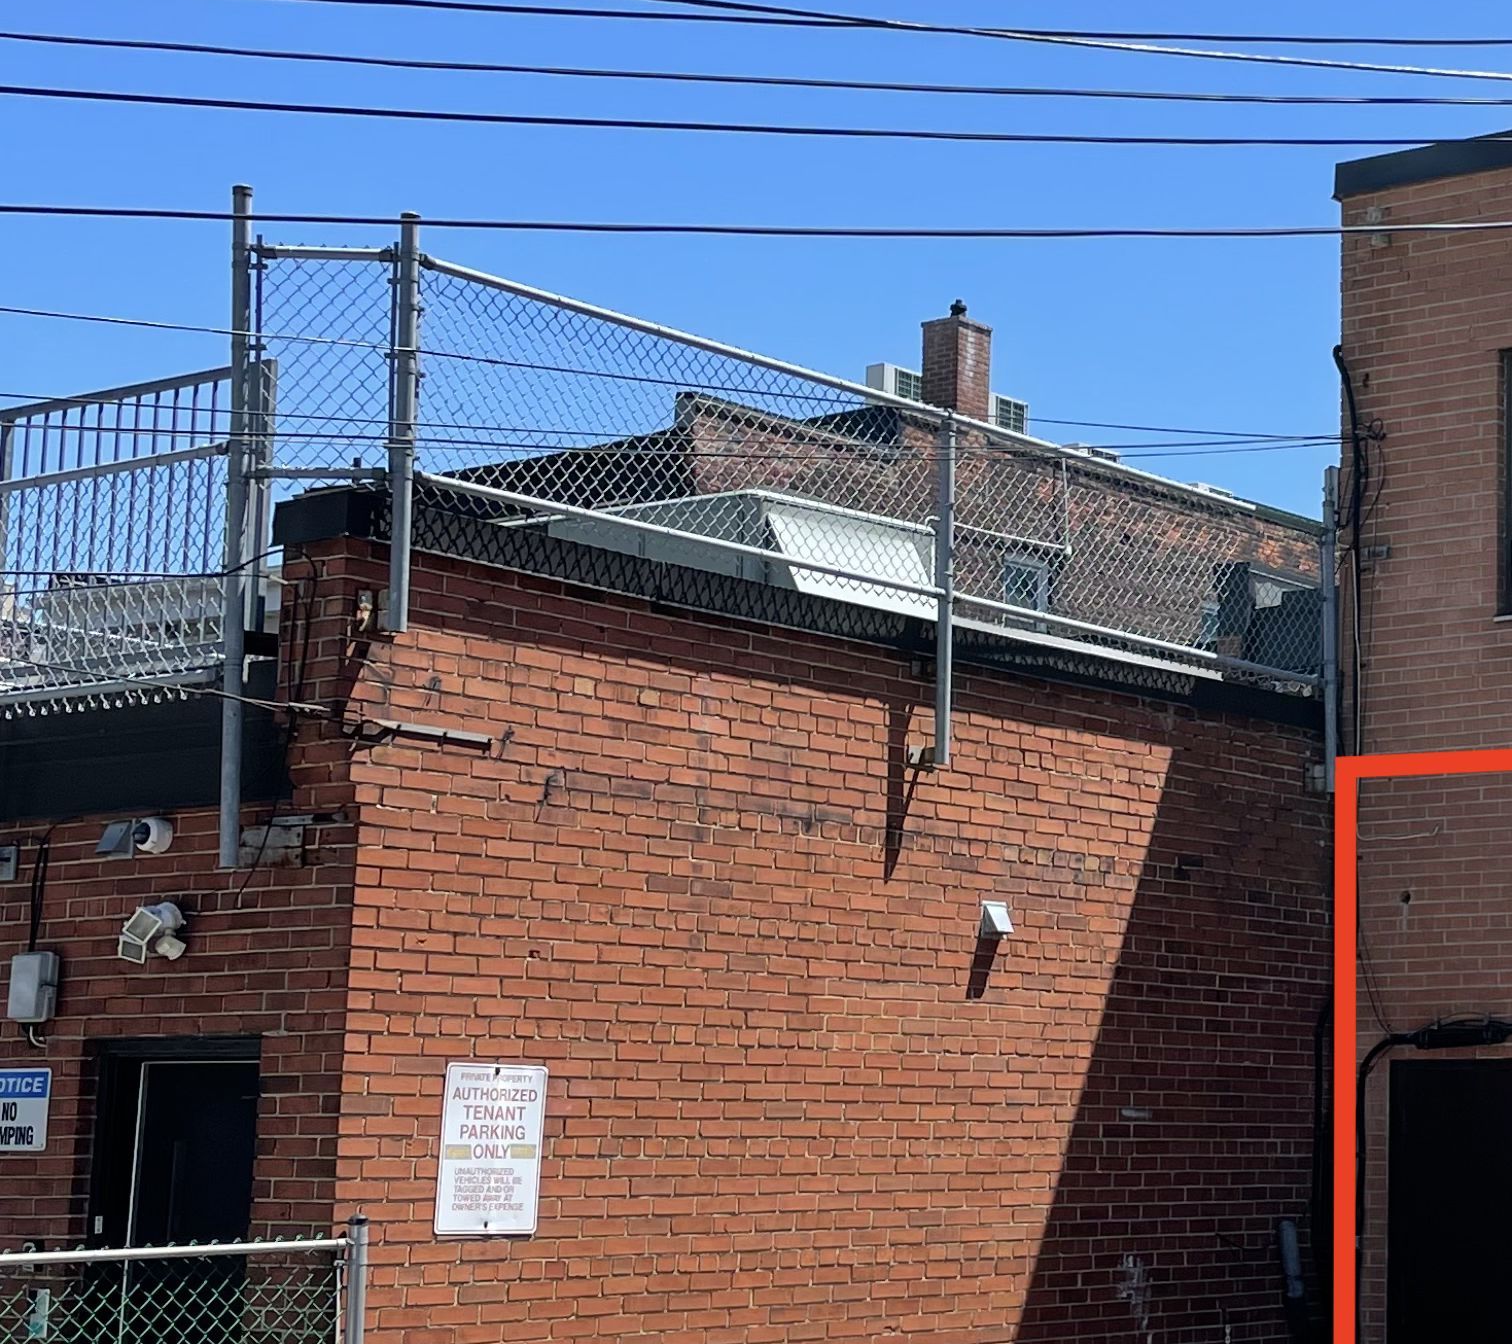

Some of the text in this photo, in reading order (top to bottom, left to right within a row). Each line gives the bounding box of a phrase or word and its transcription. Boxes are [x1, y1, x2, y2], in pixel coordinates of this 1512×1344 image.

[460, 1072, 491, 1082] PRIVATE
[0, 1077, 44, 1093] OTICE
[453, 1087, 538, 1102] AUTHORIZED
[2, 1102, 17, 1121] NO
[463, 1105, 526, 1121] TENANT
[0, 1126, 33, 1145] MPING
[460, 1124, 525, 1140] PARKING
[473, 1144, 510, 1159] ONLY
[454, 1167, 514, 1175] UNAUTHORIZED
[454, 1176, 491, 1184] VEHICLES
[493, 1176, 511, 1184] WILL
[454, 1185, 484, 1193] TAGGED
